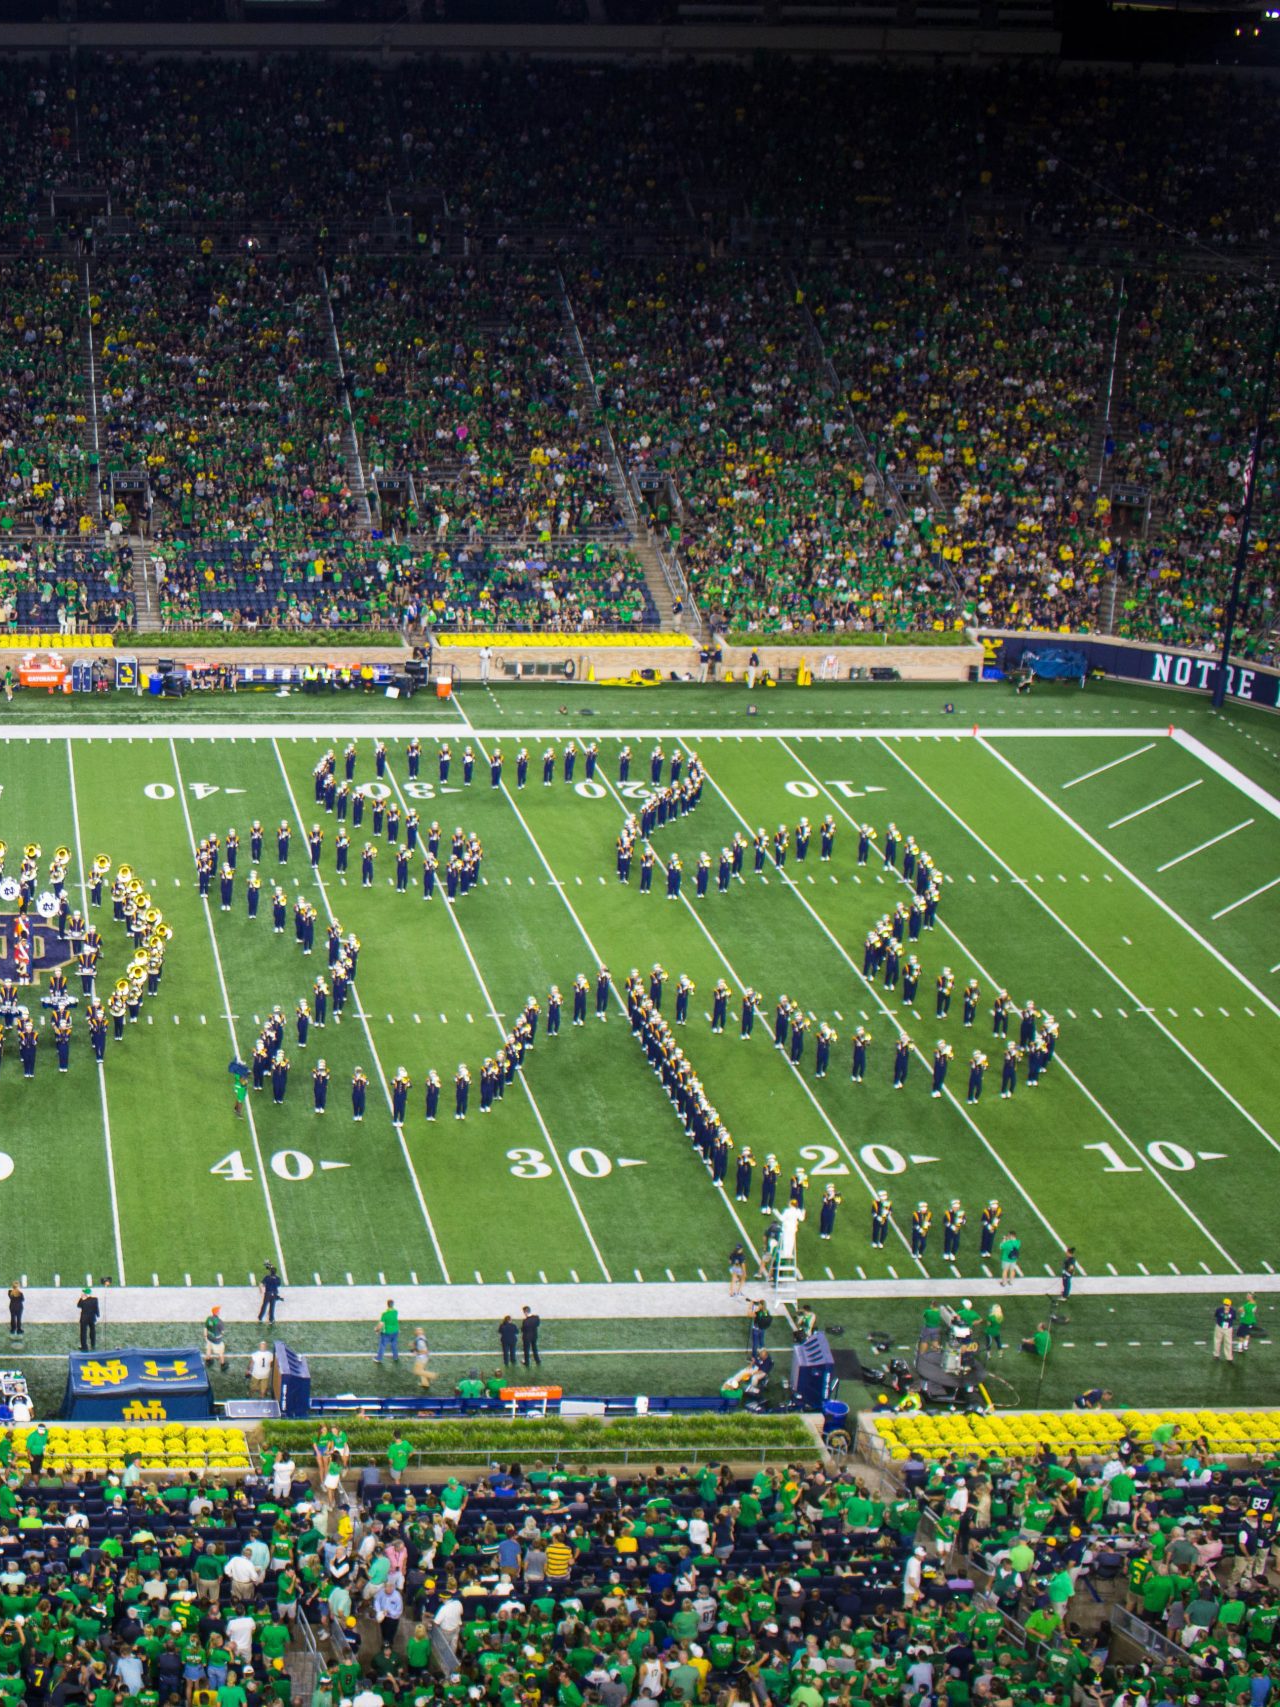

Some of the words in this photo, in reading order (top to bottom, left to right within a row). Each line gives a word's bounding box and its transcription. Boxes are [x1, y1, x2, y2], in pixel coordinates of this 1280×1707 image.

[144, 782, 214, 799] 40
[357, 782, 436, 799] 30
[574, 781, 662, 799] 20
[785, 780, 866, 798] 10
[210, 1149, 314, 1181] 40
[506, 1147, 612, 1179] 30
[800, 1143, 907, 1176] 20
[1084, 1140, 1197, 1172] 10
[1252, 1497, 1270, 1511] 83
[34, 1669, 45, 1687] 7
